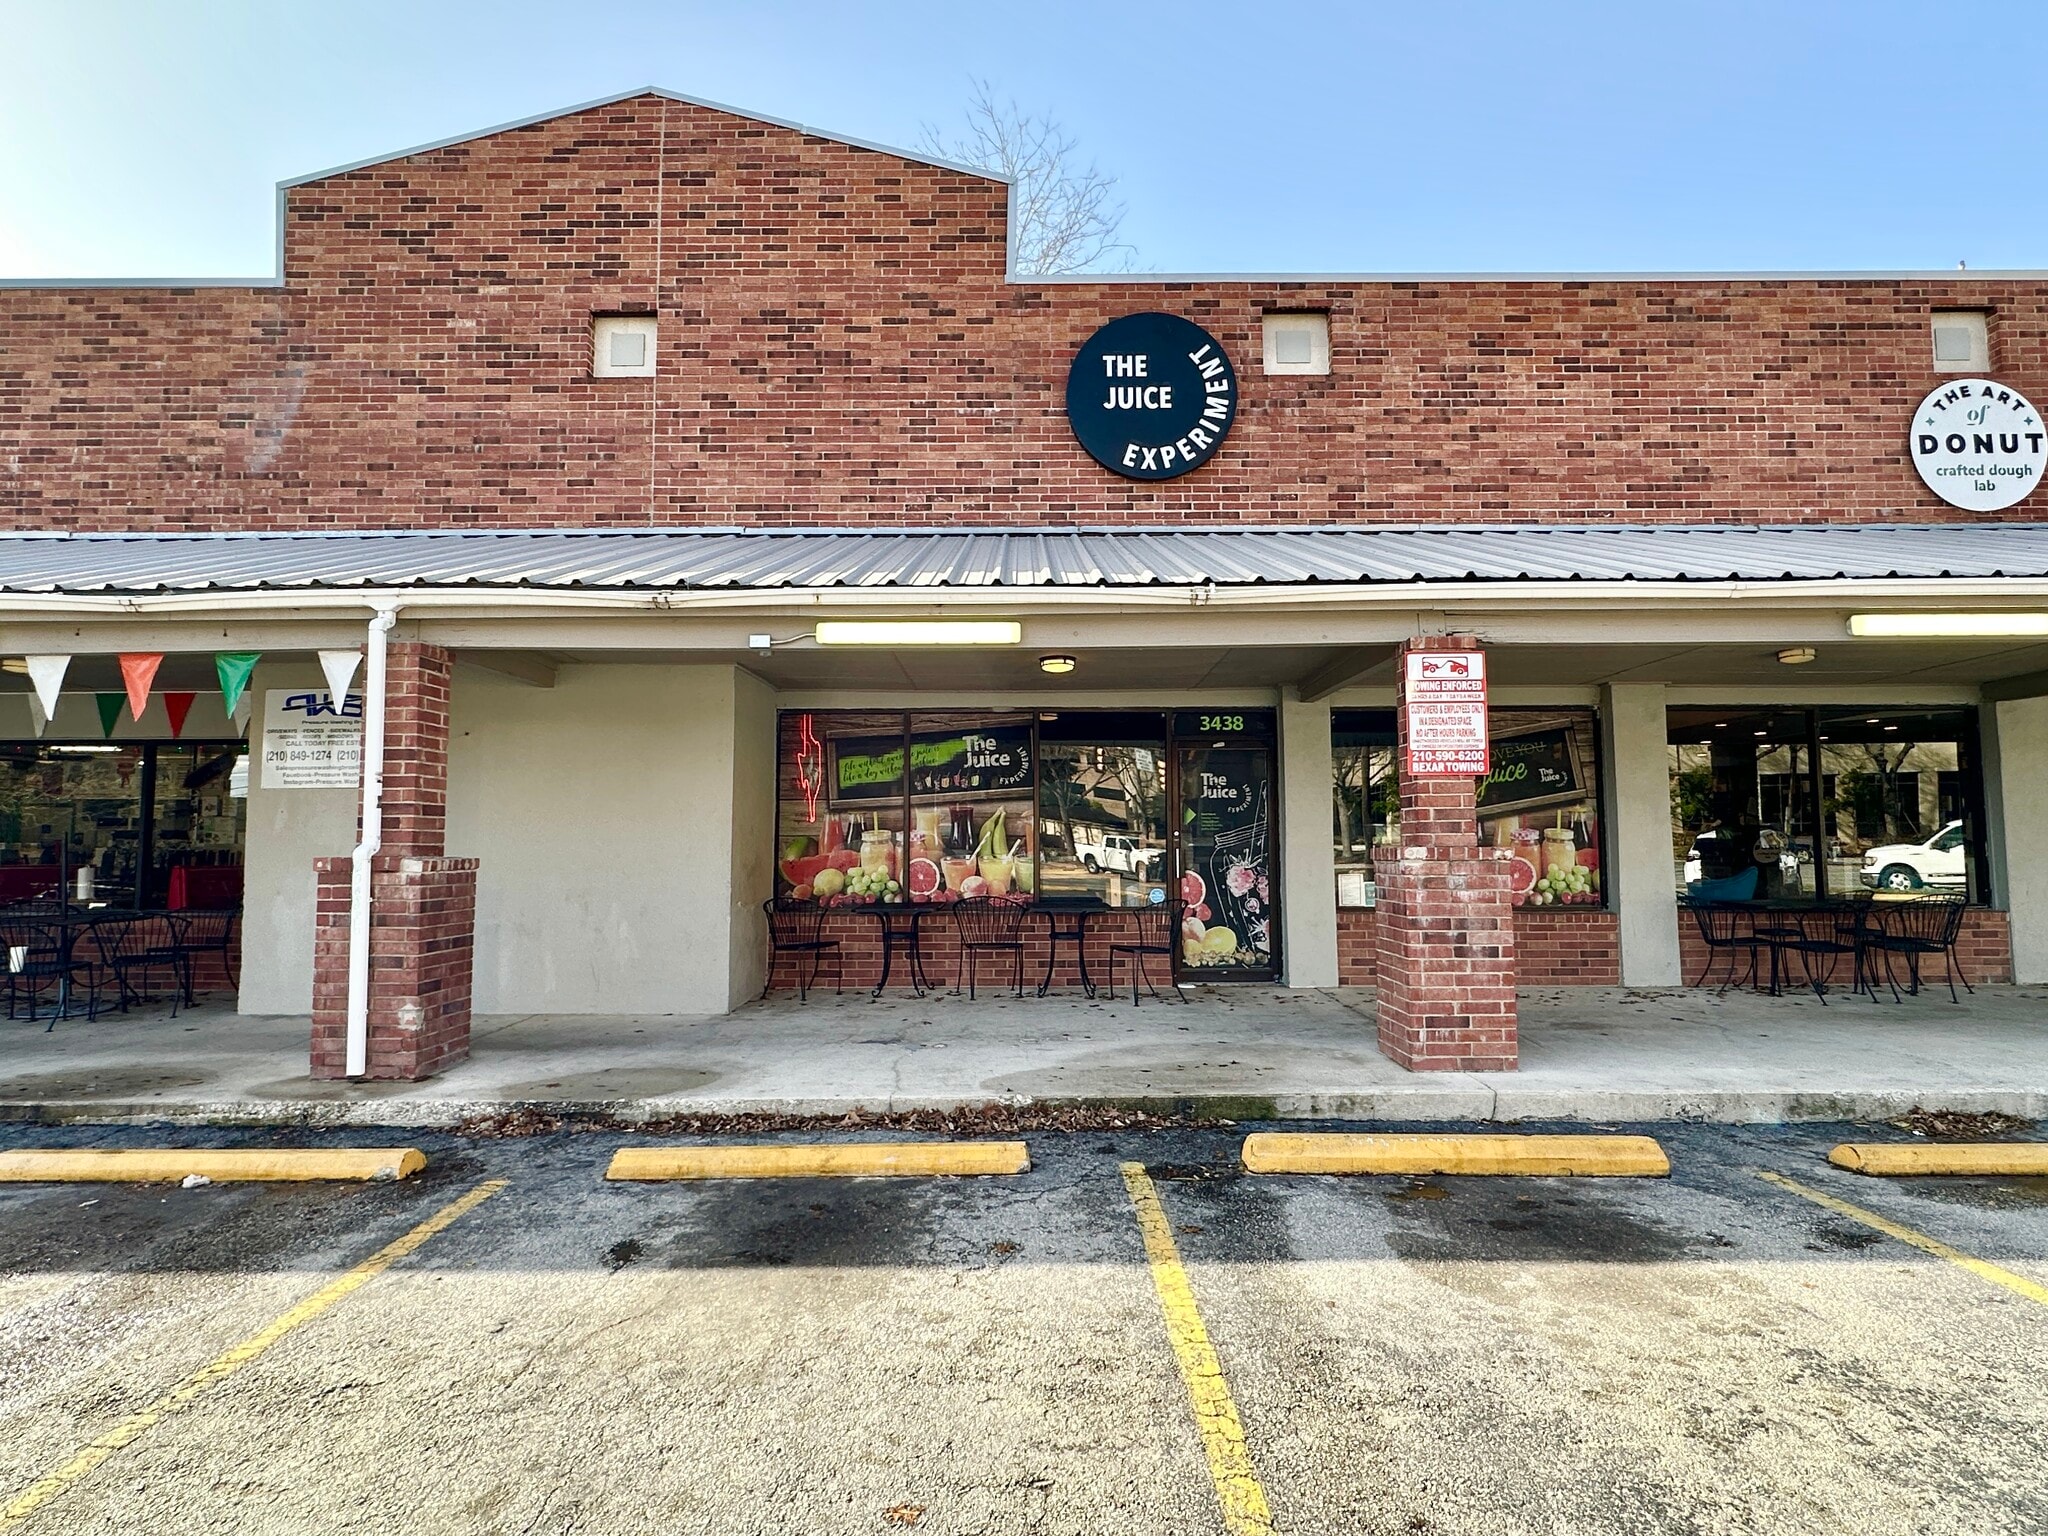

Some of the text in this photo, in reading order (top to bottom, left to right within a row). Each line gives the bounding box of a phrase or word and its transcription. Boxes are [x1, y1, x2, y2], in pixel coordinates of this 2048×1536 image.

[1102, 355, 1148, 377] THE
[1103, 386, 1173, 409] JUICE
[1932, 385, 2027, 411] THE ART
[1122, 343, 1230, 470] EXPERIMENT
[1966, 404, 1991, 426] of
[1919, 433, 2044, 455] DONUT
[1936, 464, 2033, 479] crafted dough
[1974, 480, 1996, 491] lab
[1411, 680, 1482, 691] OWING ENFORCED
[1411, 704, 1438, 714] CUSTOMERS
[1200, 716, 1244, 731] 3438
[1428, 717, 1457, 726] DESIGNATED
[1457, 716, 1472, 726] SPACE
[1416, 728, 1476, 737] NO AFTER HOURS PARKING
[962, 735, 997, 752] The
[266, 750, 359, 763] (210) 849-1274 (210)
[963, 752, 1011, 768] Juice
[1412, 750, 1485, 761] 210-590-6200
[1000, 746, 1029, 785] EXPERIMENT
[1412, 761, 1485, 772] BEXAR TOWING
[1200, 773, 1227, 786] The
[1540, 773, 1560, 783] Juice
[1200, 785, 1238, 799] Juice
